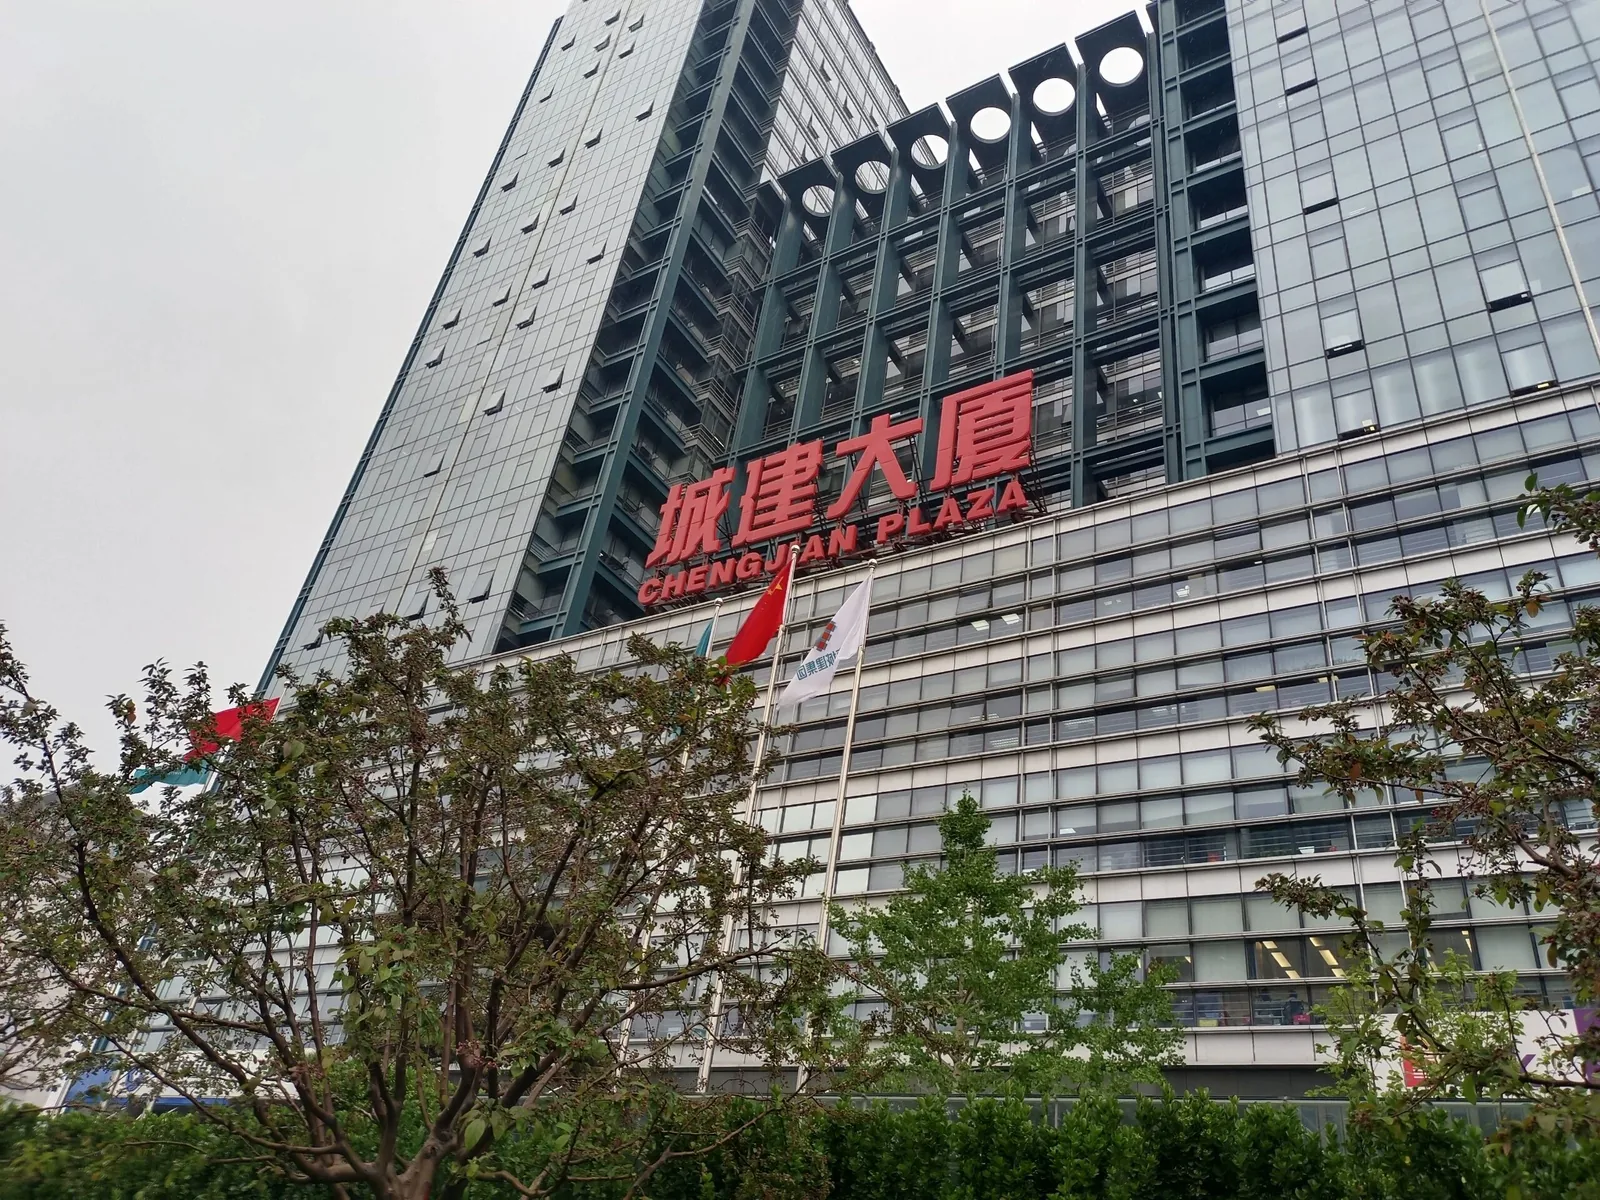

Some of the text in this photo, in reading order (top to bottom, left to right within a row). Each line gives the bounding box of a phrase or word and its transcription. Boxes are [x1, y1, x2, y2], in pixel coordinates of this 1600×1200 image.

[637, 479, 1029, 605] CHENGJIAN PLAZA
[646, 370, 1034, 568] 城建大厦
